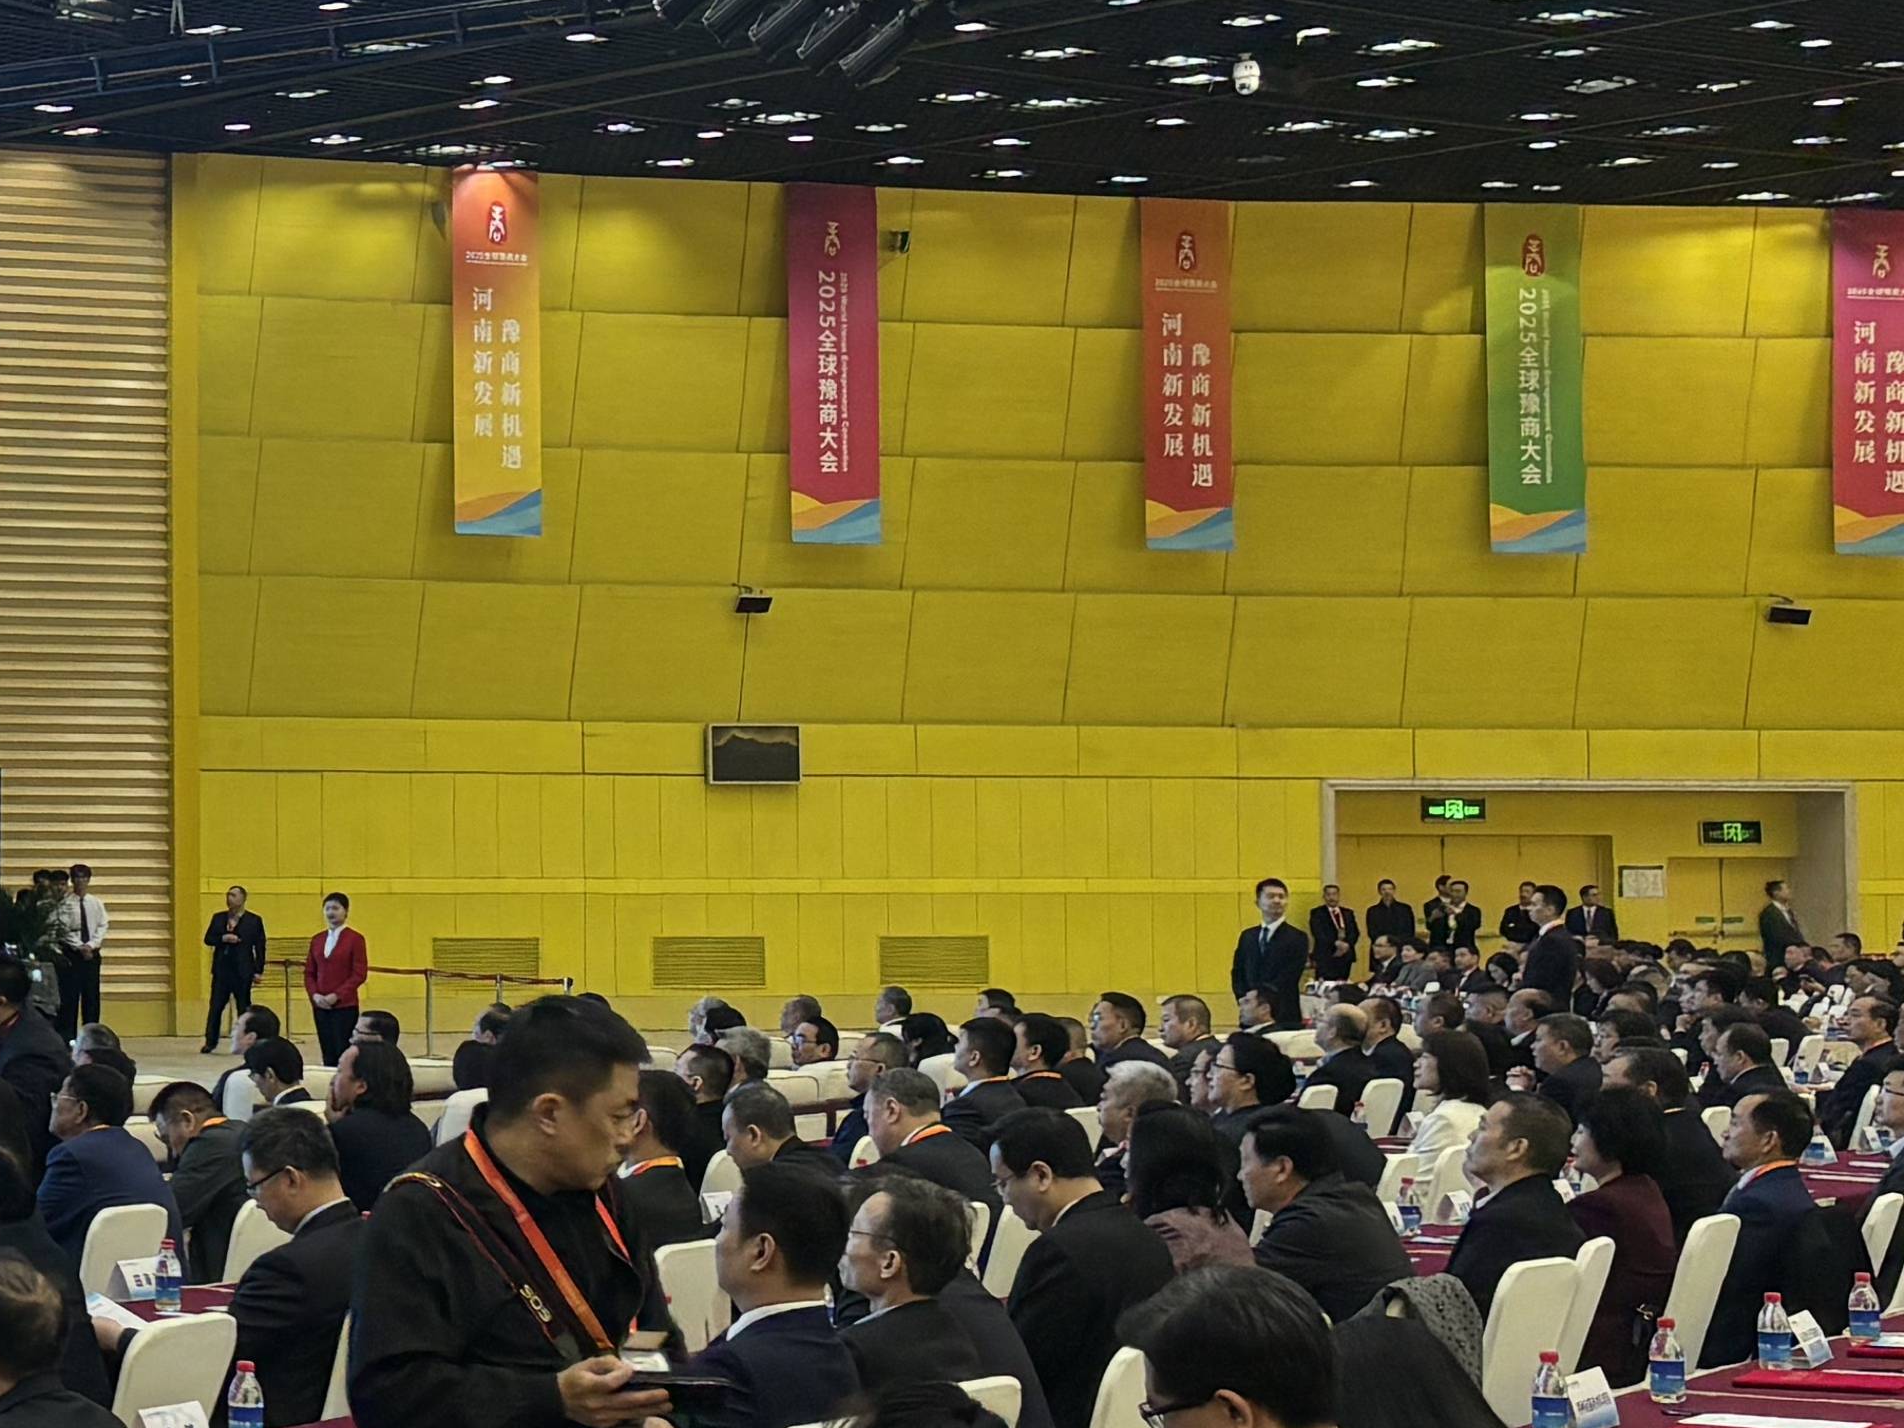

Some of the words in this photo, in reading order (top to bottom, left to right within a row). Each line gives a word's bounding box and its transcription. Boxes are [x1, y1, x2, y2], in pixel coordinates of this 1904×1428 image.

[473, 286, 494, 439] 河南新发展
[500, 318, 523, 470] 豫商新机遇
[817, 270, 839, 474] 2025全球豫商大会
[1161, 312, 1184, 458] 河南新发展
[1191, 342, 1214, 488] 豫商新机遇
[1518, 287, 1543, 486] 2025全球豫商大会
[1853, 320, 1876, 464] 河南新发展
[1884, 350, 1904, 494] 豫商新机遇
